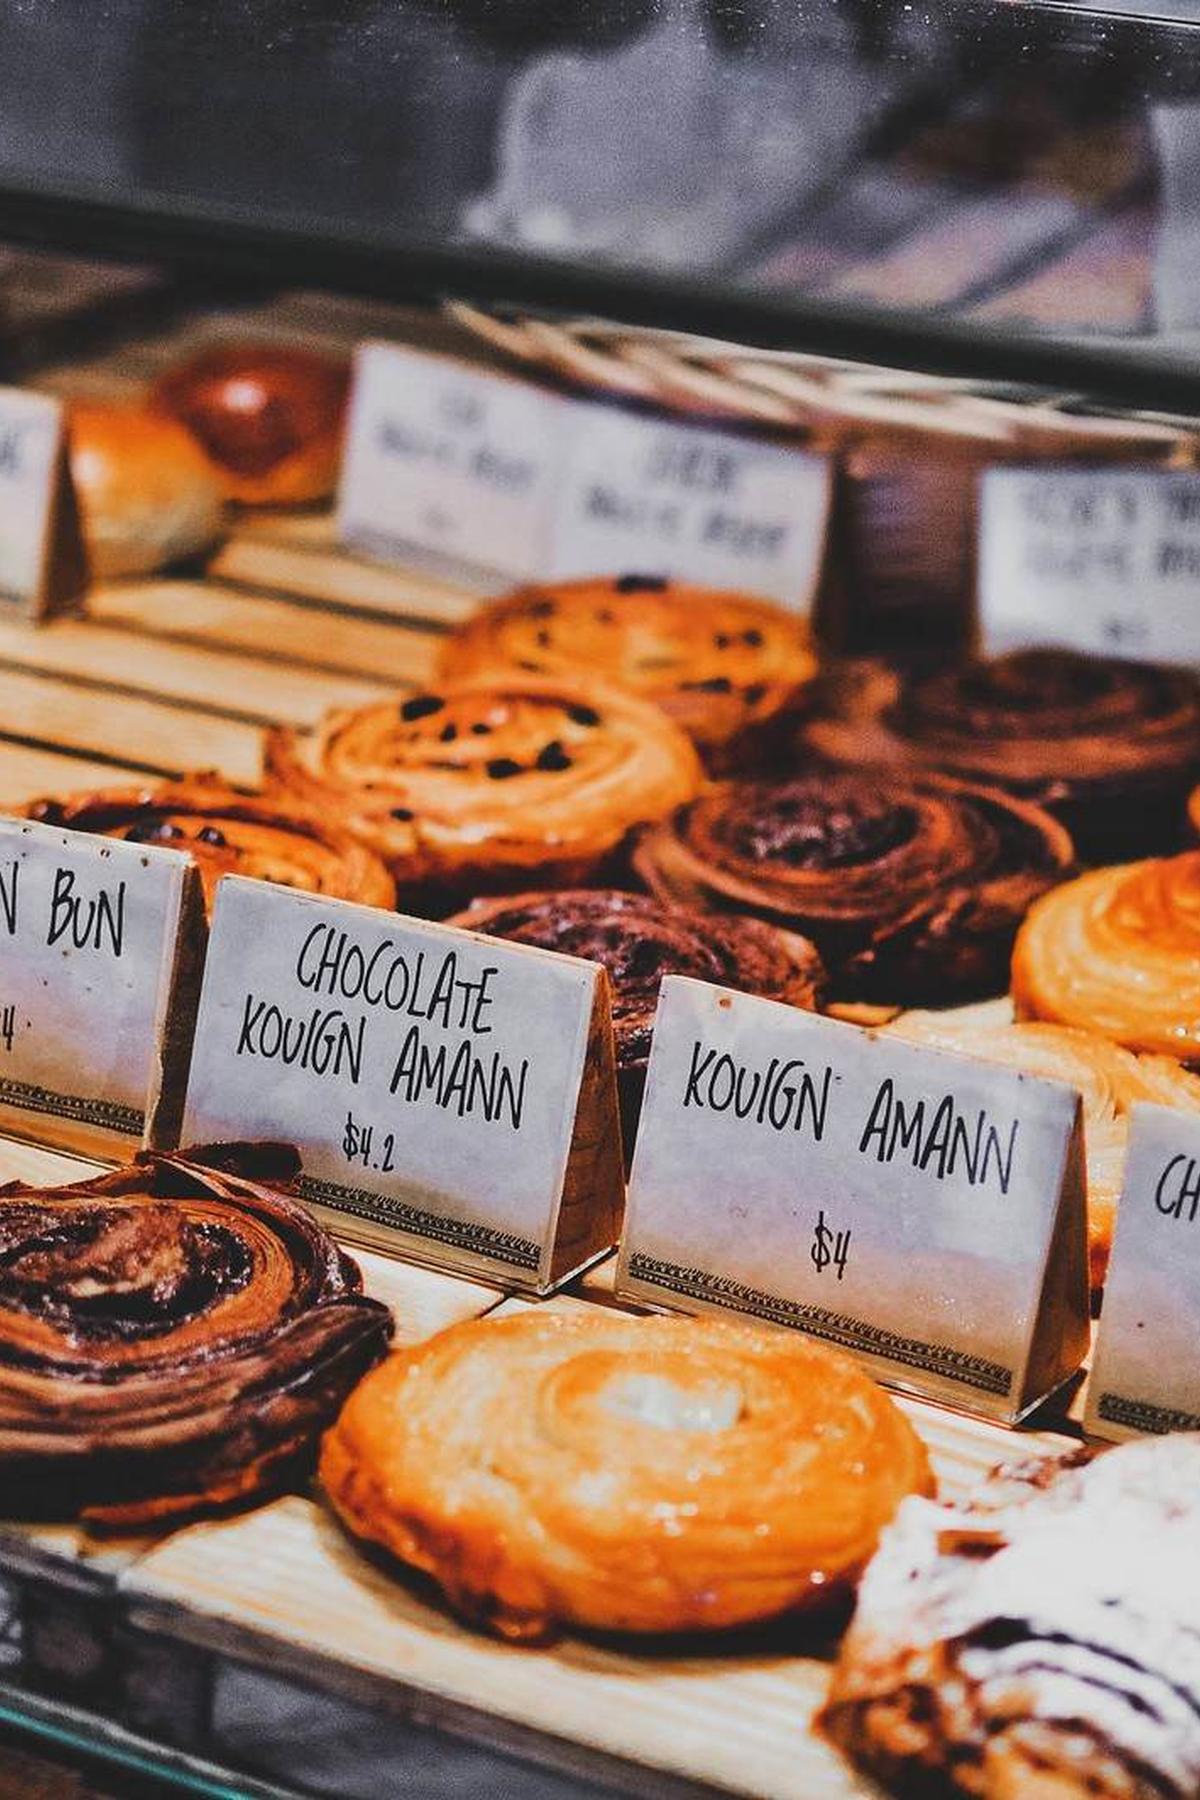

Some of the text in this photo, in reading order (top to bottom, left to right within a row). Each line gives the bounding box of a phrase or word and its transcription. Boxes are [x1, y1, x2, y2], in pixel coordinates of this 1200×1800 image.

[47, 868, 126, 957] BUN
[297, 923, 499, 1034] CHOCOLATE
[237, 994, 529, 1130] KOUIGN AMANN
[342, 1112, 395, 1172] $4.2
[683, 1041, 1019, 1194] KOUIGN AMANN
[811, 1211, 851, 1280] $4
